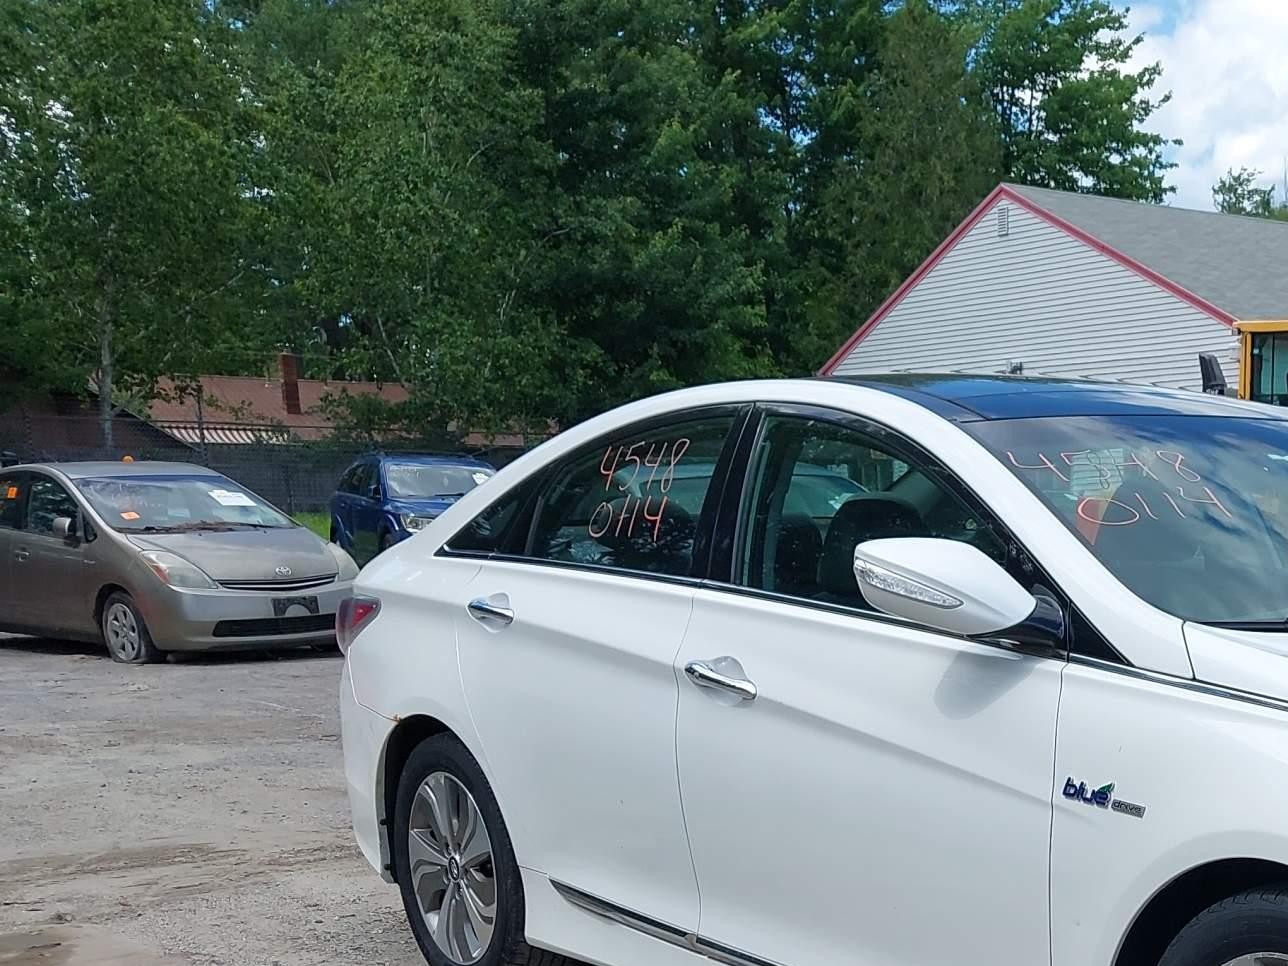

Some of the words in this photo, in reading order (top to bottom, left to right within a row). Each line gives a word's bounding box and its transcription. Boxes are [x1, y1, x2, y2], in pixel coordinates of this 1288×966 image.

[600, 438, 690, 492] 4548
[1006, 449, 1201, 489] 4548
[588, 495, 669, 542] 0114
[1077, 486, 1233, 525] 0114
[1062, 777, 1111, 808] blue
